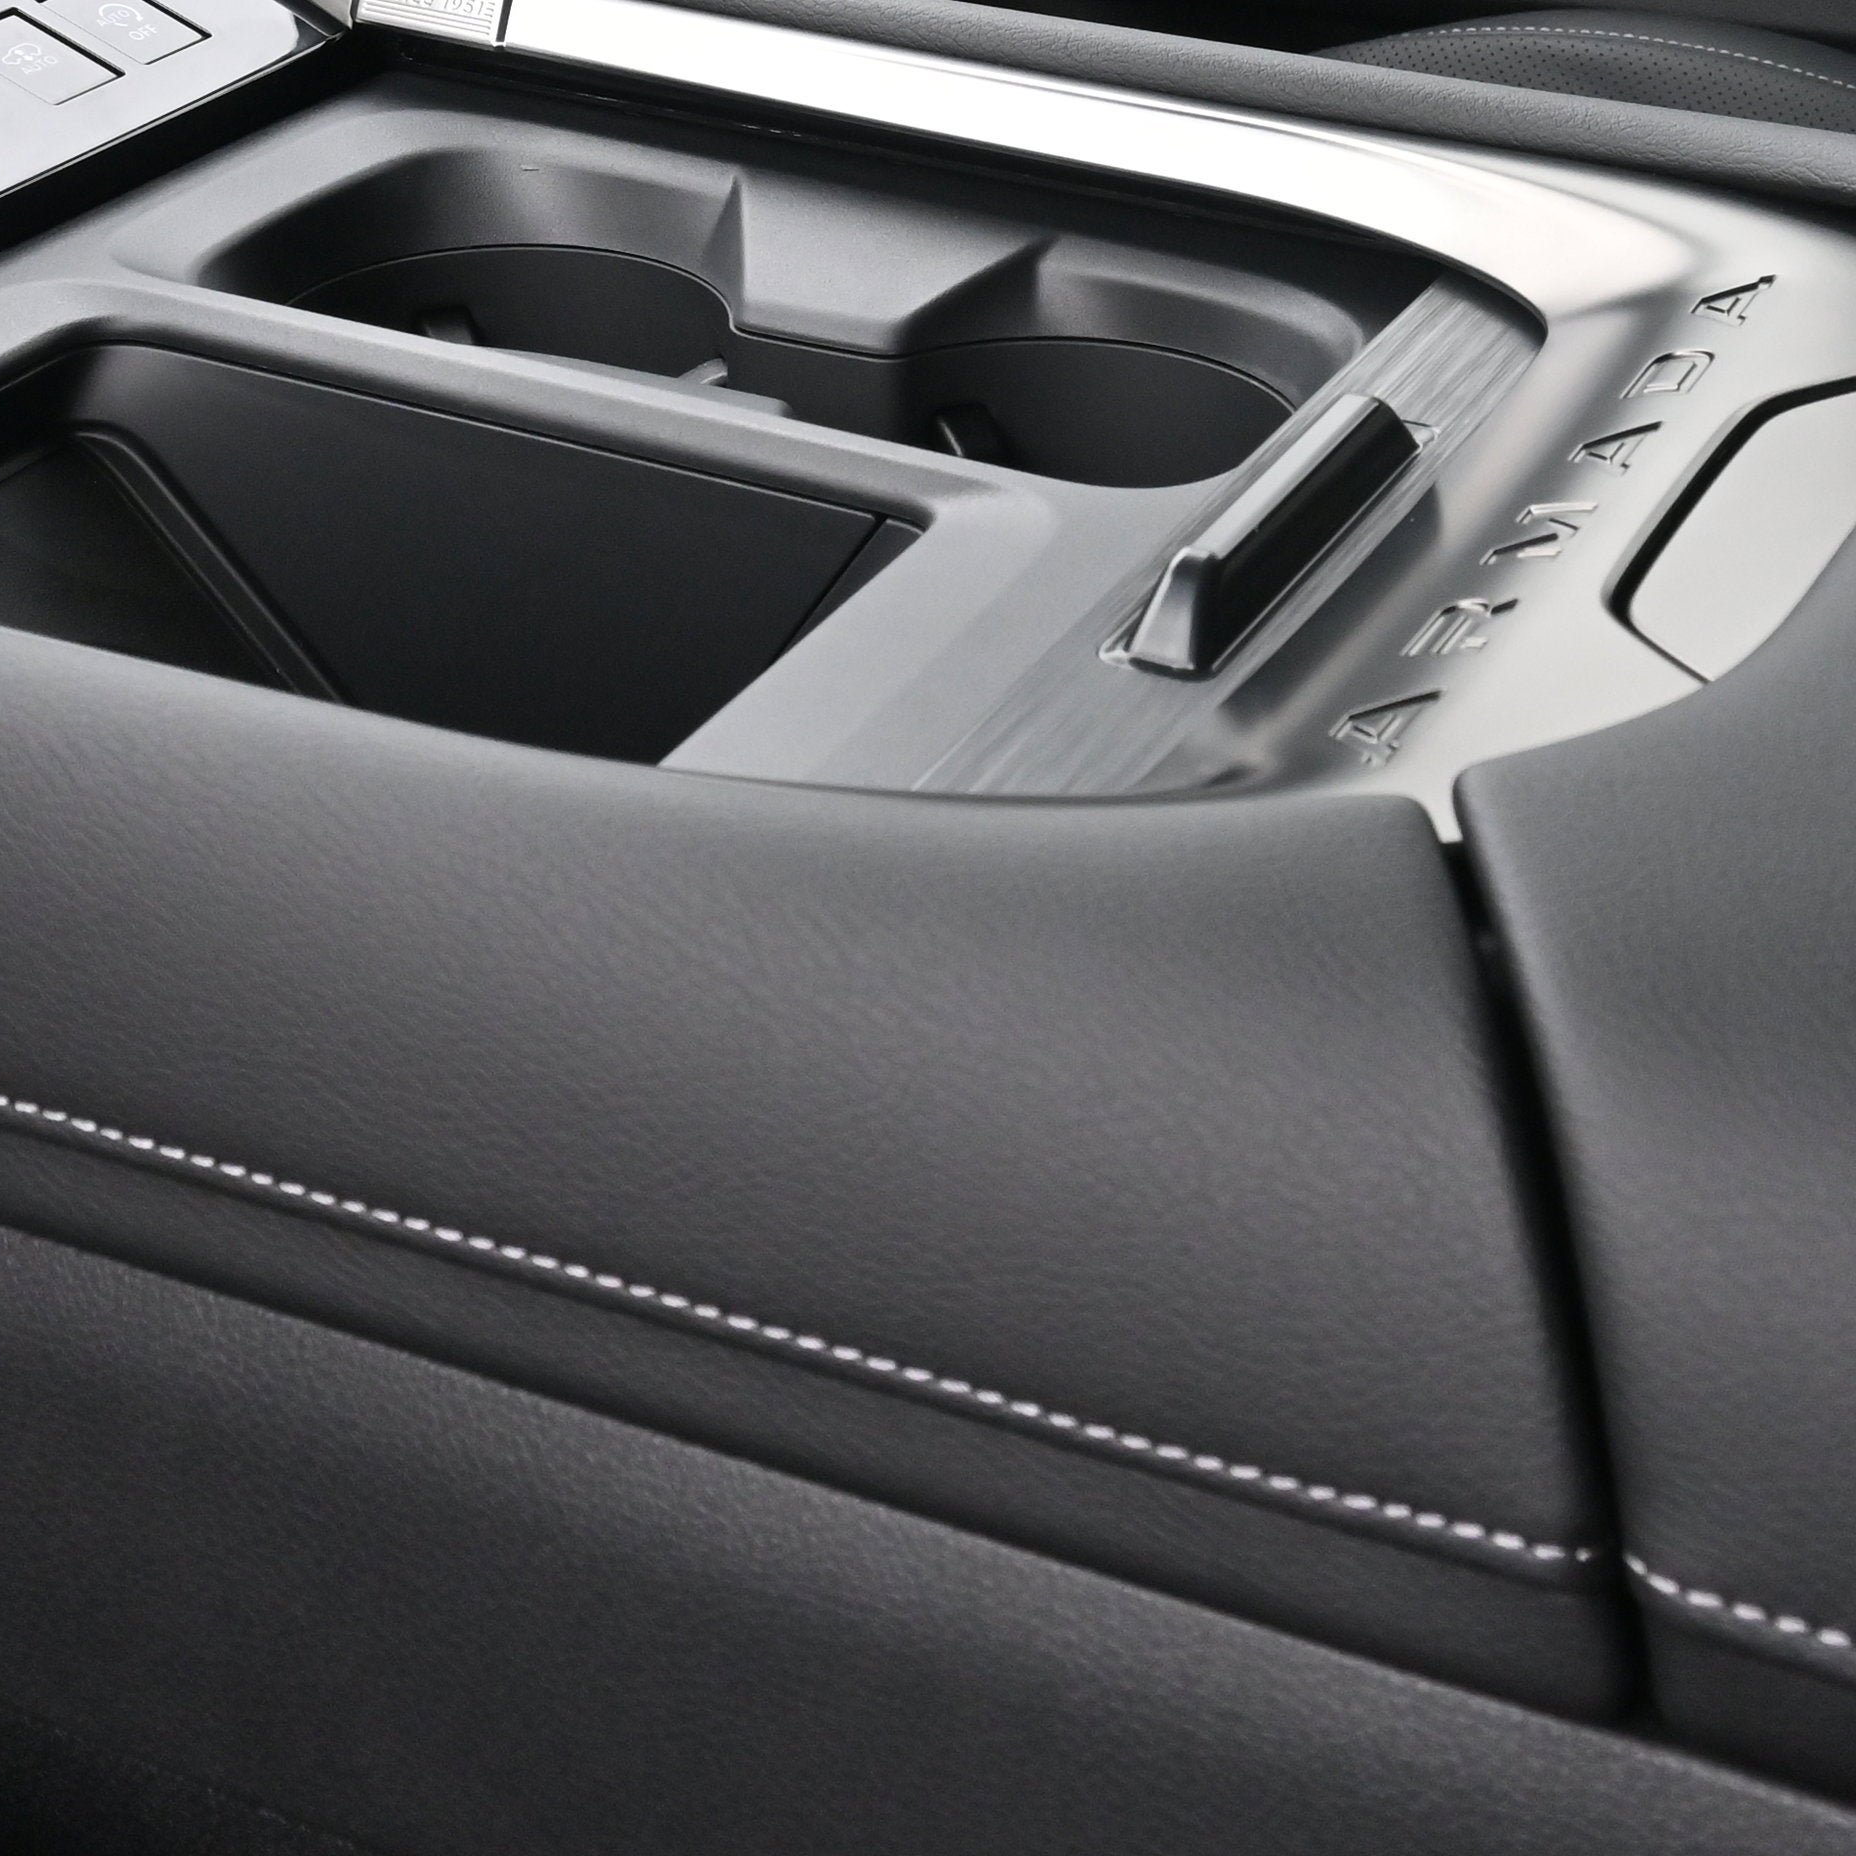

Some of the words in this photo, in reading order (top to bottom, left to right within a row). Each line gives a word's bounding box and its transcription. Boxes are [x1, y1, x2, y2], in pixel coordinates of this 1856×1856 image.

[96, 9, 131, 28] AUTO
[128, 23, 159, 41] OFF
[22, 55, 59, 75] AUTO
[1328, 272, 1777, 768] ARMADA
